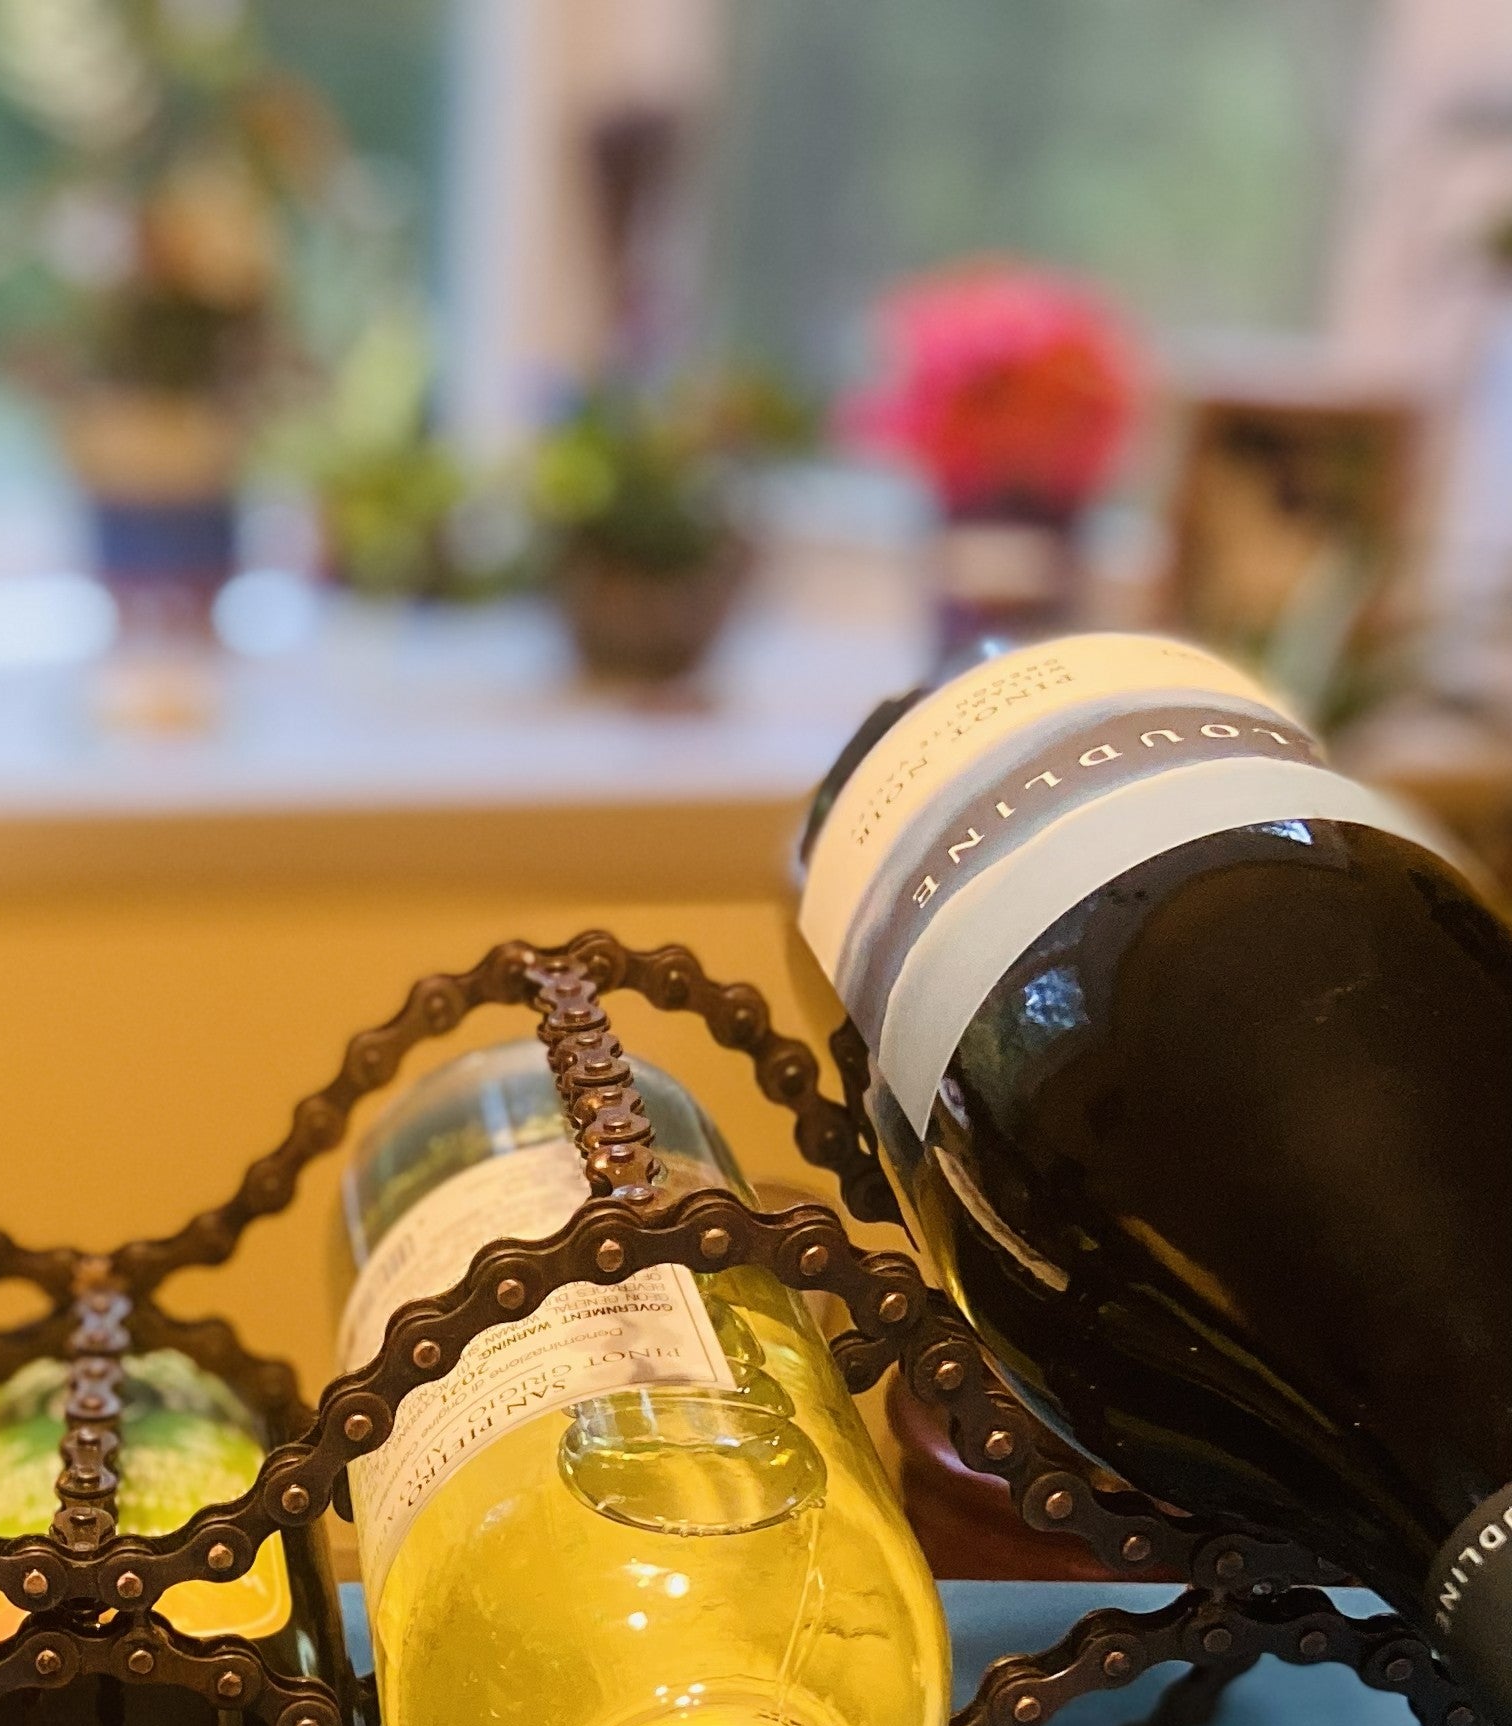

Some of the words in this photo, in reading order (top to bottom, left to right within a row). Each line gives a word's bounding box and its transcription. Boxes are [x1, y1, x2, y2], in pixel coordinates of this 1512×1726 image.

[911, 724, 1296, 910] LOUDLINE
[560, 1303, 674, 1326] GOVERNMENT
[489, 1327, 624, 1380] Denominazione
[585, 1347, 681, 1369] PINOT
[441, 1362, 489, 1405] 2021
[467, 1365, 572, 1424] GRIGIO
[507, 1380, 566, 1416] SAN
[407, 1417, 493, 1507] PIETRO
